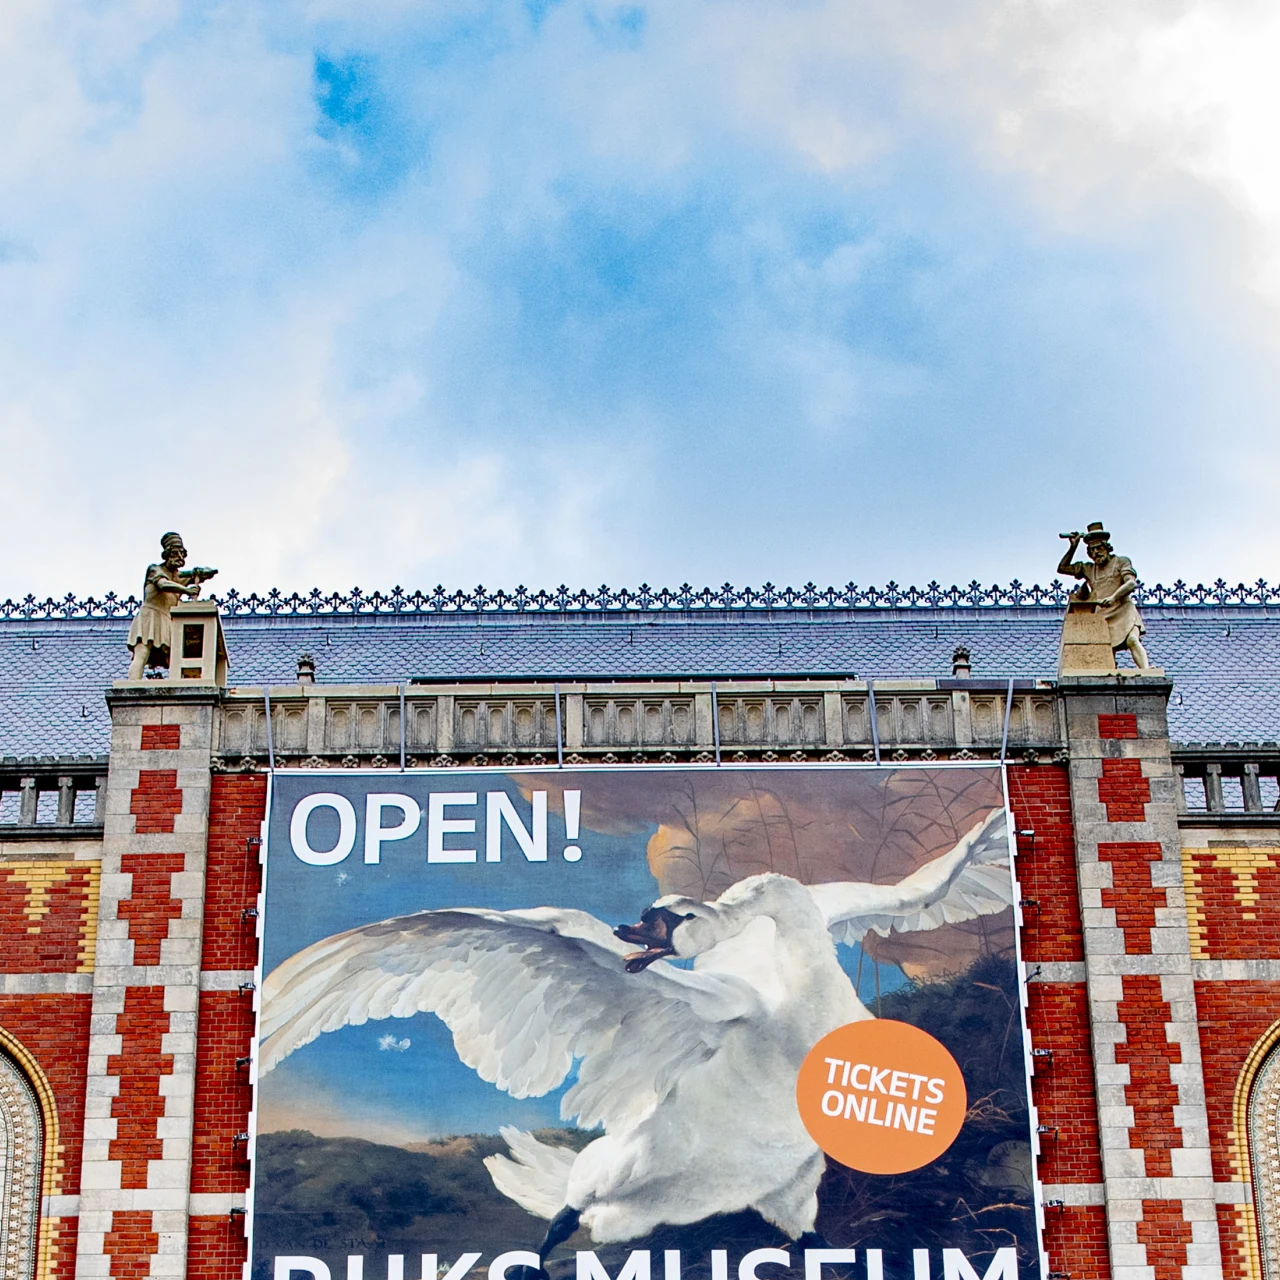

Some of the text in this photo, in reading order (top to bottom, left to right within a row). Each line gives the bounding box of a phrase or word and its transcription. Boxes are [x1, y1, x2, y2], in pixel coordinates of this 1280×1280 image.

[290, 789, 582, 865] OPEN!
[824, 1057, 945, 1104] TICKETS
[821, 1090, 937, 1136] ONLINE
